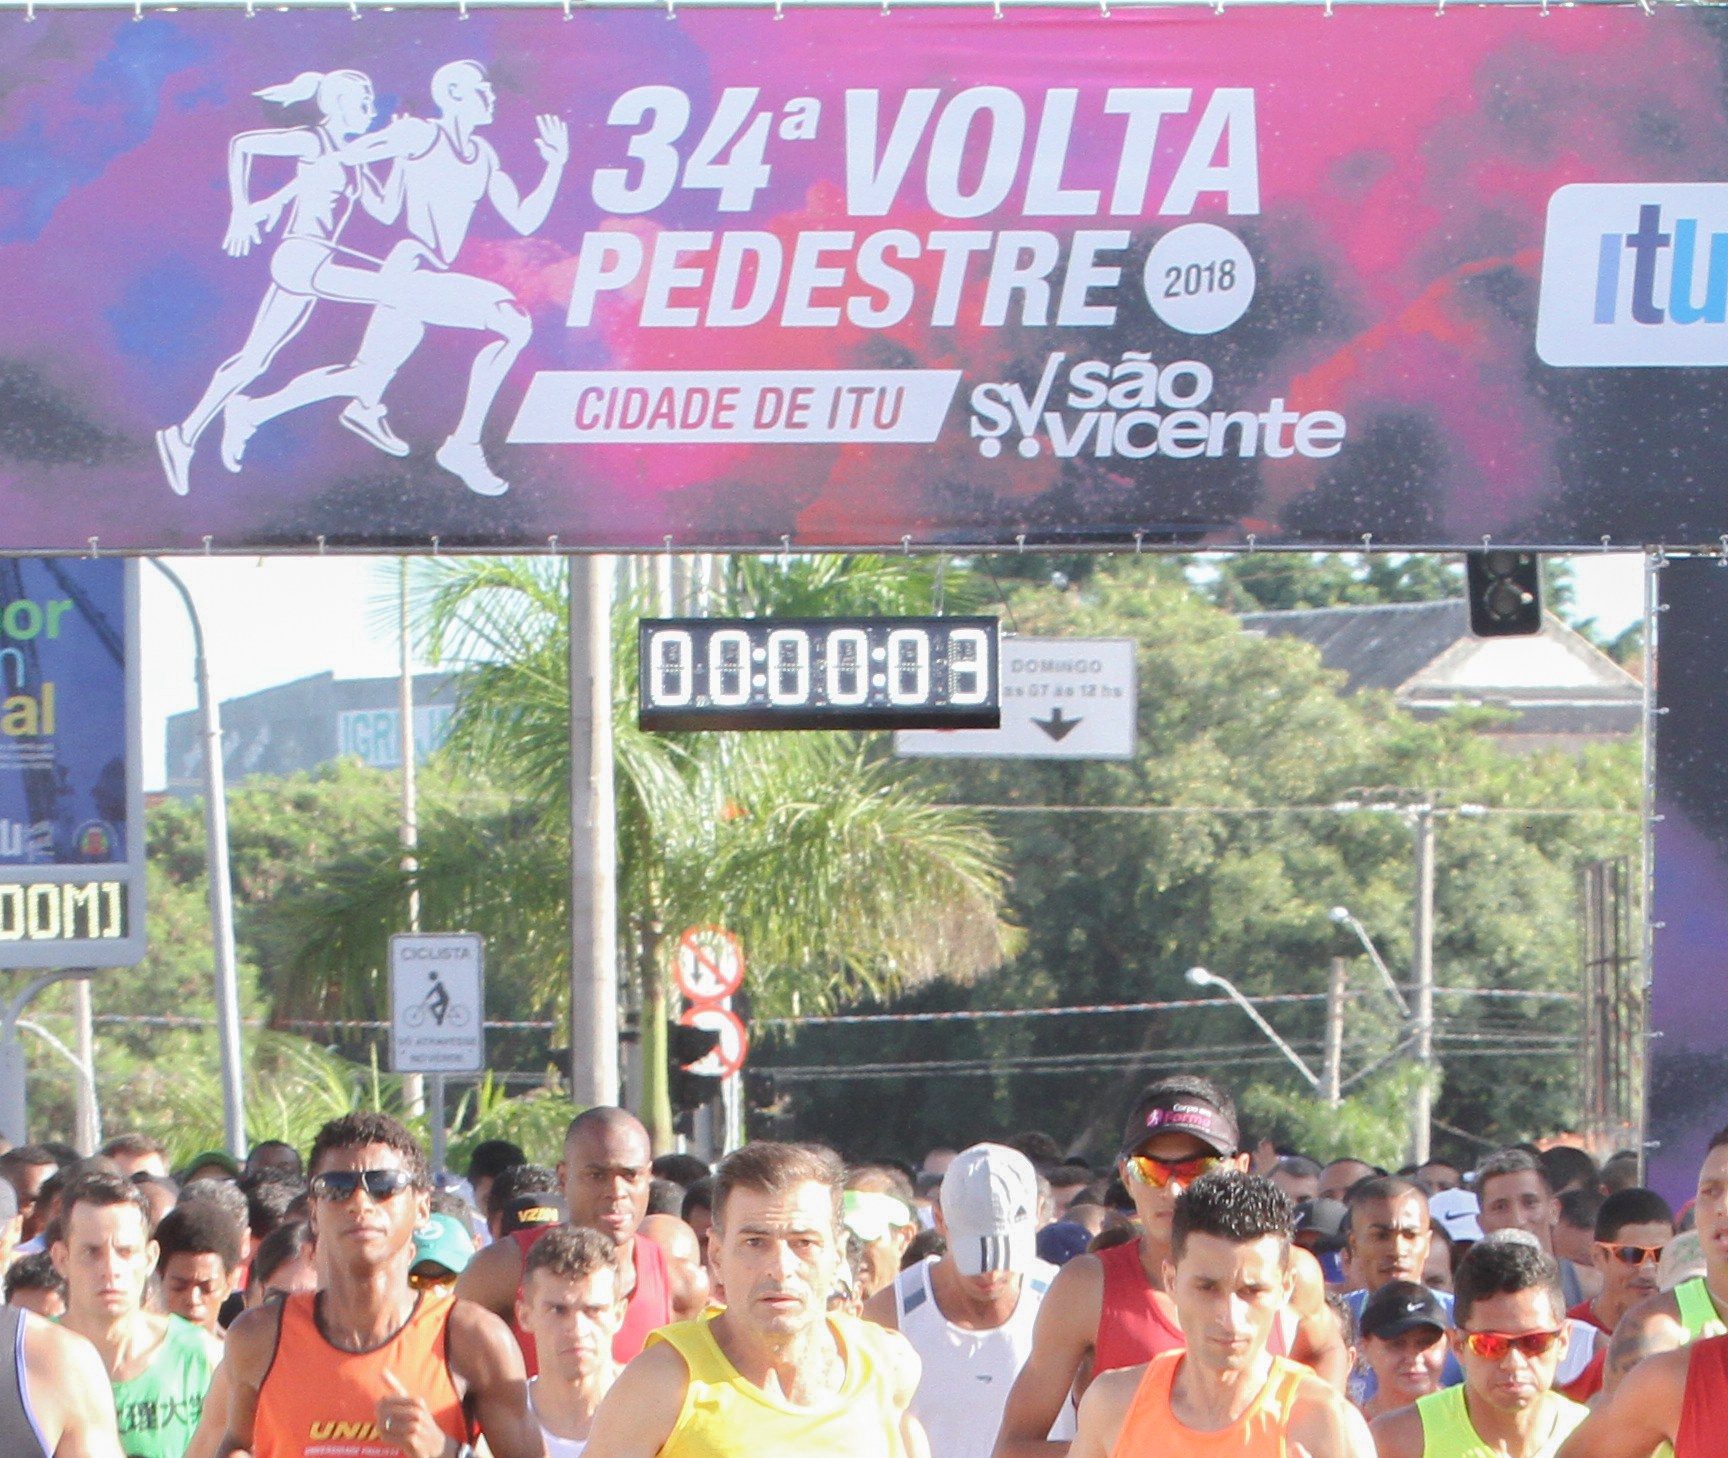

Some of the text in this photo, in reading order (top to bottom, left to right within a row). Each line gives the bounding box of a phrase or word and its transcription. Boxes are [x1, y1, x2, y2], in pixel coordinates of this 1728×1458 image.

[589, 84, 1260, 217] 34ª VOLTA
[566, 230, 1131, 328] PEDESTRE
[1164, 259, 1235, 298] 2018
[576, 386, 905, 430] CIDADE DE ITU
[1067, 351, 1213, 409] são
[1044, 398, 1346, 458] vicente
